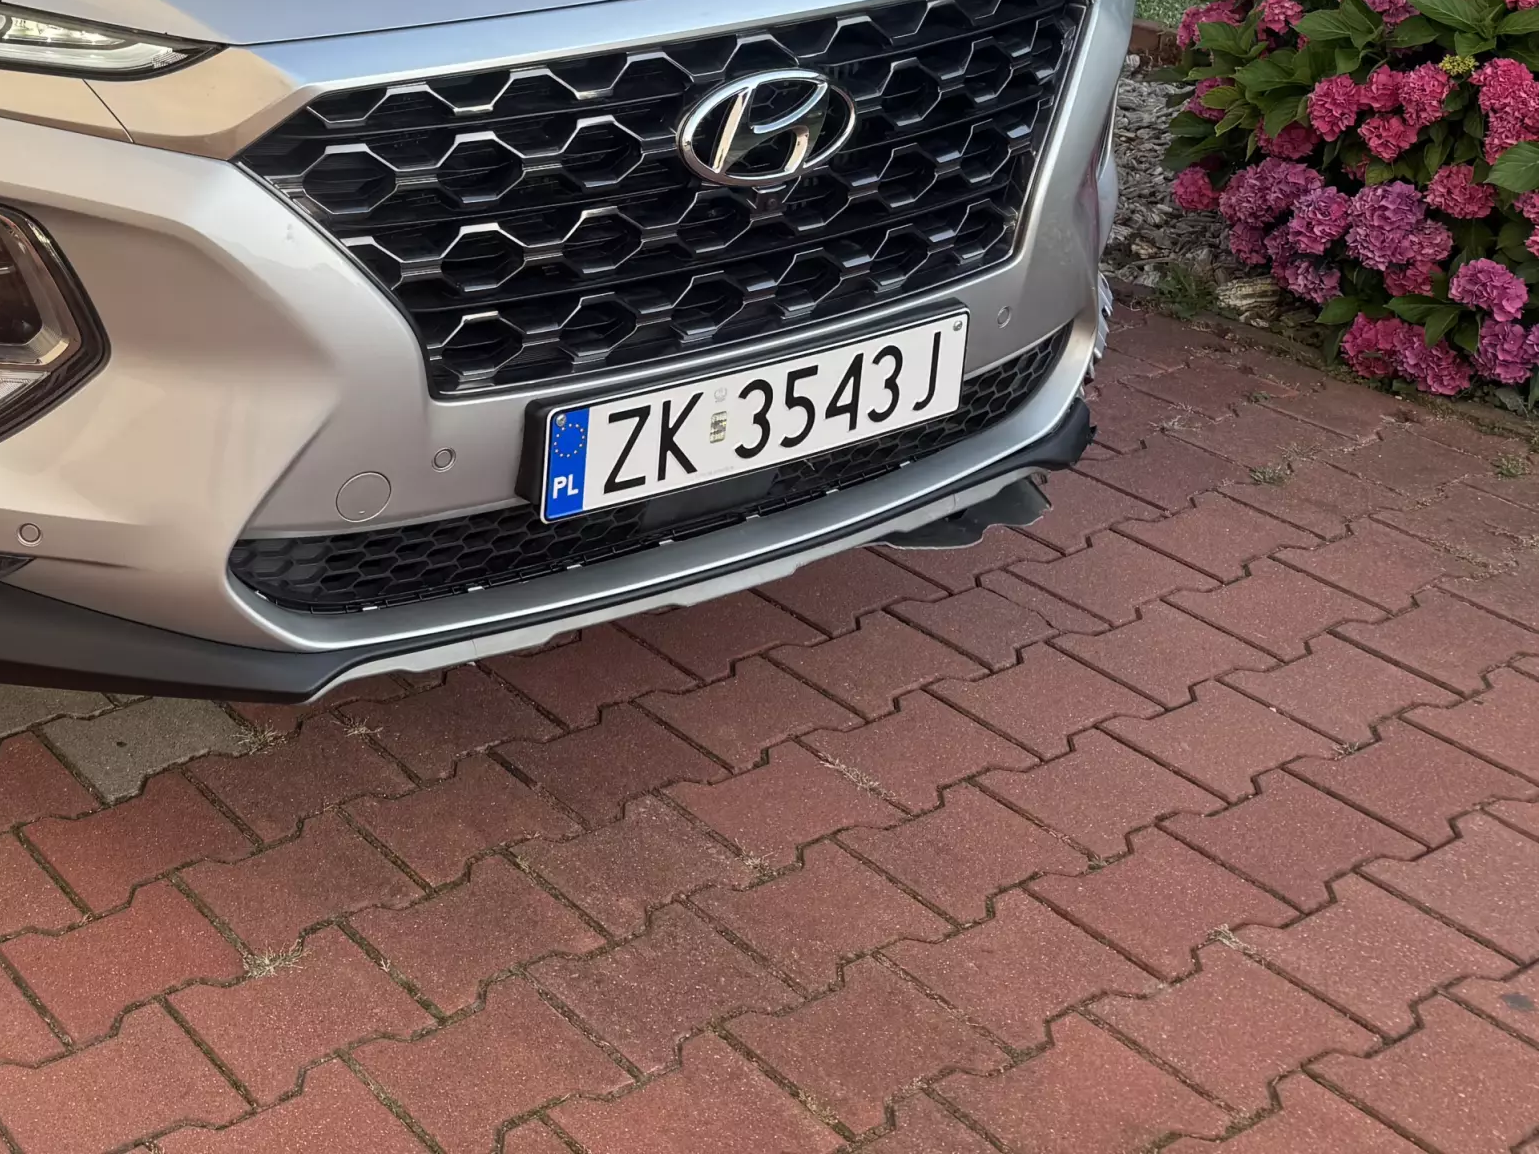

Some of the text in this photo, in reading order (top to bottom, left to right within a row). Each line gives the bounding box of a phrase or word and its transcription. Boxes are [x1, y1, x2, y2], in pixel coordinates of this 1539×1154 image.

[602, 331, 942, 495] ZK 3543J
[552, 474, 579, 499] PL
